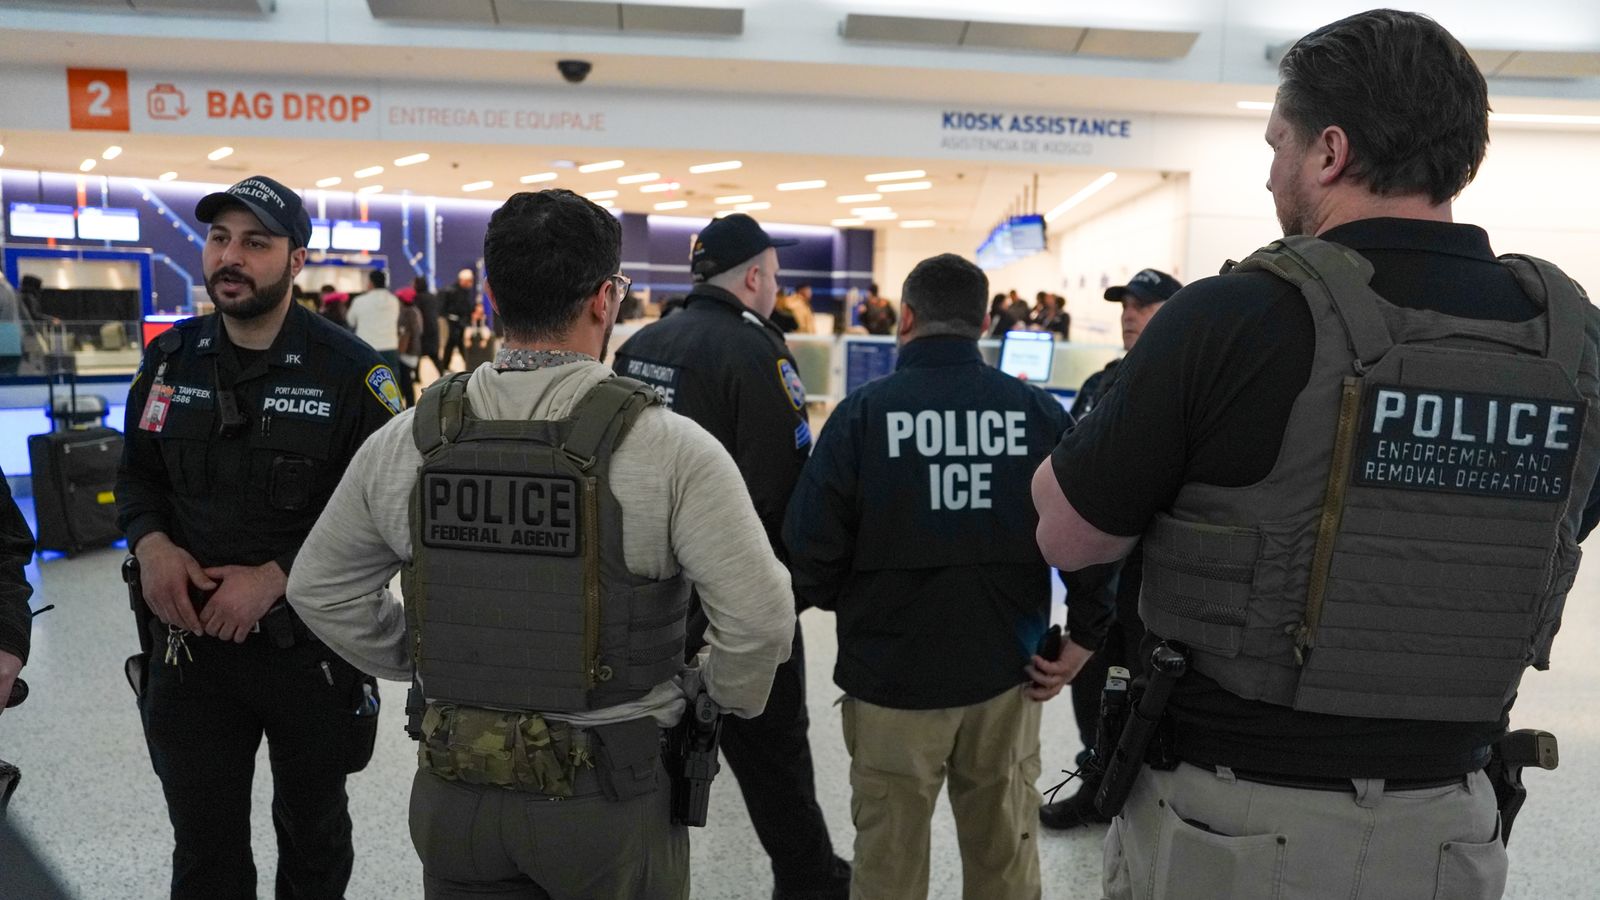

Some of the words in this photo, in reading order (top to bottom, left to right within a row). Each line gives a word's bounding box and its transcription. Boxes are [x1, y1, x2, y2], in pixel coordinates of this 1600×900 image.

[86, 80, 112, 117] 2
[207, 91, 273, 119] BAG
[283, 93, 371, 122] DROP
[389, 106, 479, 128] ENTREGA
[484, 109, 510, 129] DE
[515, 111, 605, 131] EQUIPAJE
[942, 111, 1003, 131] KIOSK
[1009, 115, 1132, 138] ASSISTANCE
[232, 186, 270, 202] POLICE
[244, 179, 286, 208] AUTHORITY
[198, 337, 211, 348] JFK
[285, 353, 302, 364] JFK
[171, 394, 191, 404] 2586
[178, 385, 211, 399] TAWFEEK
[275, 386, 291, 395] PORT
[291, 388, 324, 397] AUTHORITY
[263, 397, 331, 417] POLICE
[1372, 389, 1575, 450] POLICE
[886, 410, 1028, 457] POLICE
[1376, 440, 1508, 469] ENFORCEMENT
[1515, 453, 1551, 473] AND
[929, 463, 993, 511] ICE
[1365, 461, 1446, 487] REMOVAL
[1455, 469, 1562, 496] OPERATIONS
[430, 477, 571, 529] POLICE
[431, 524, 502, 544] FEDERAL
[511, 529, 570, 549] AGENT
